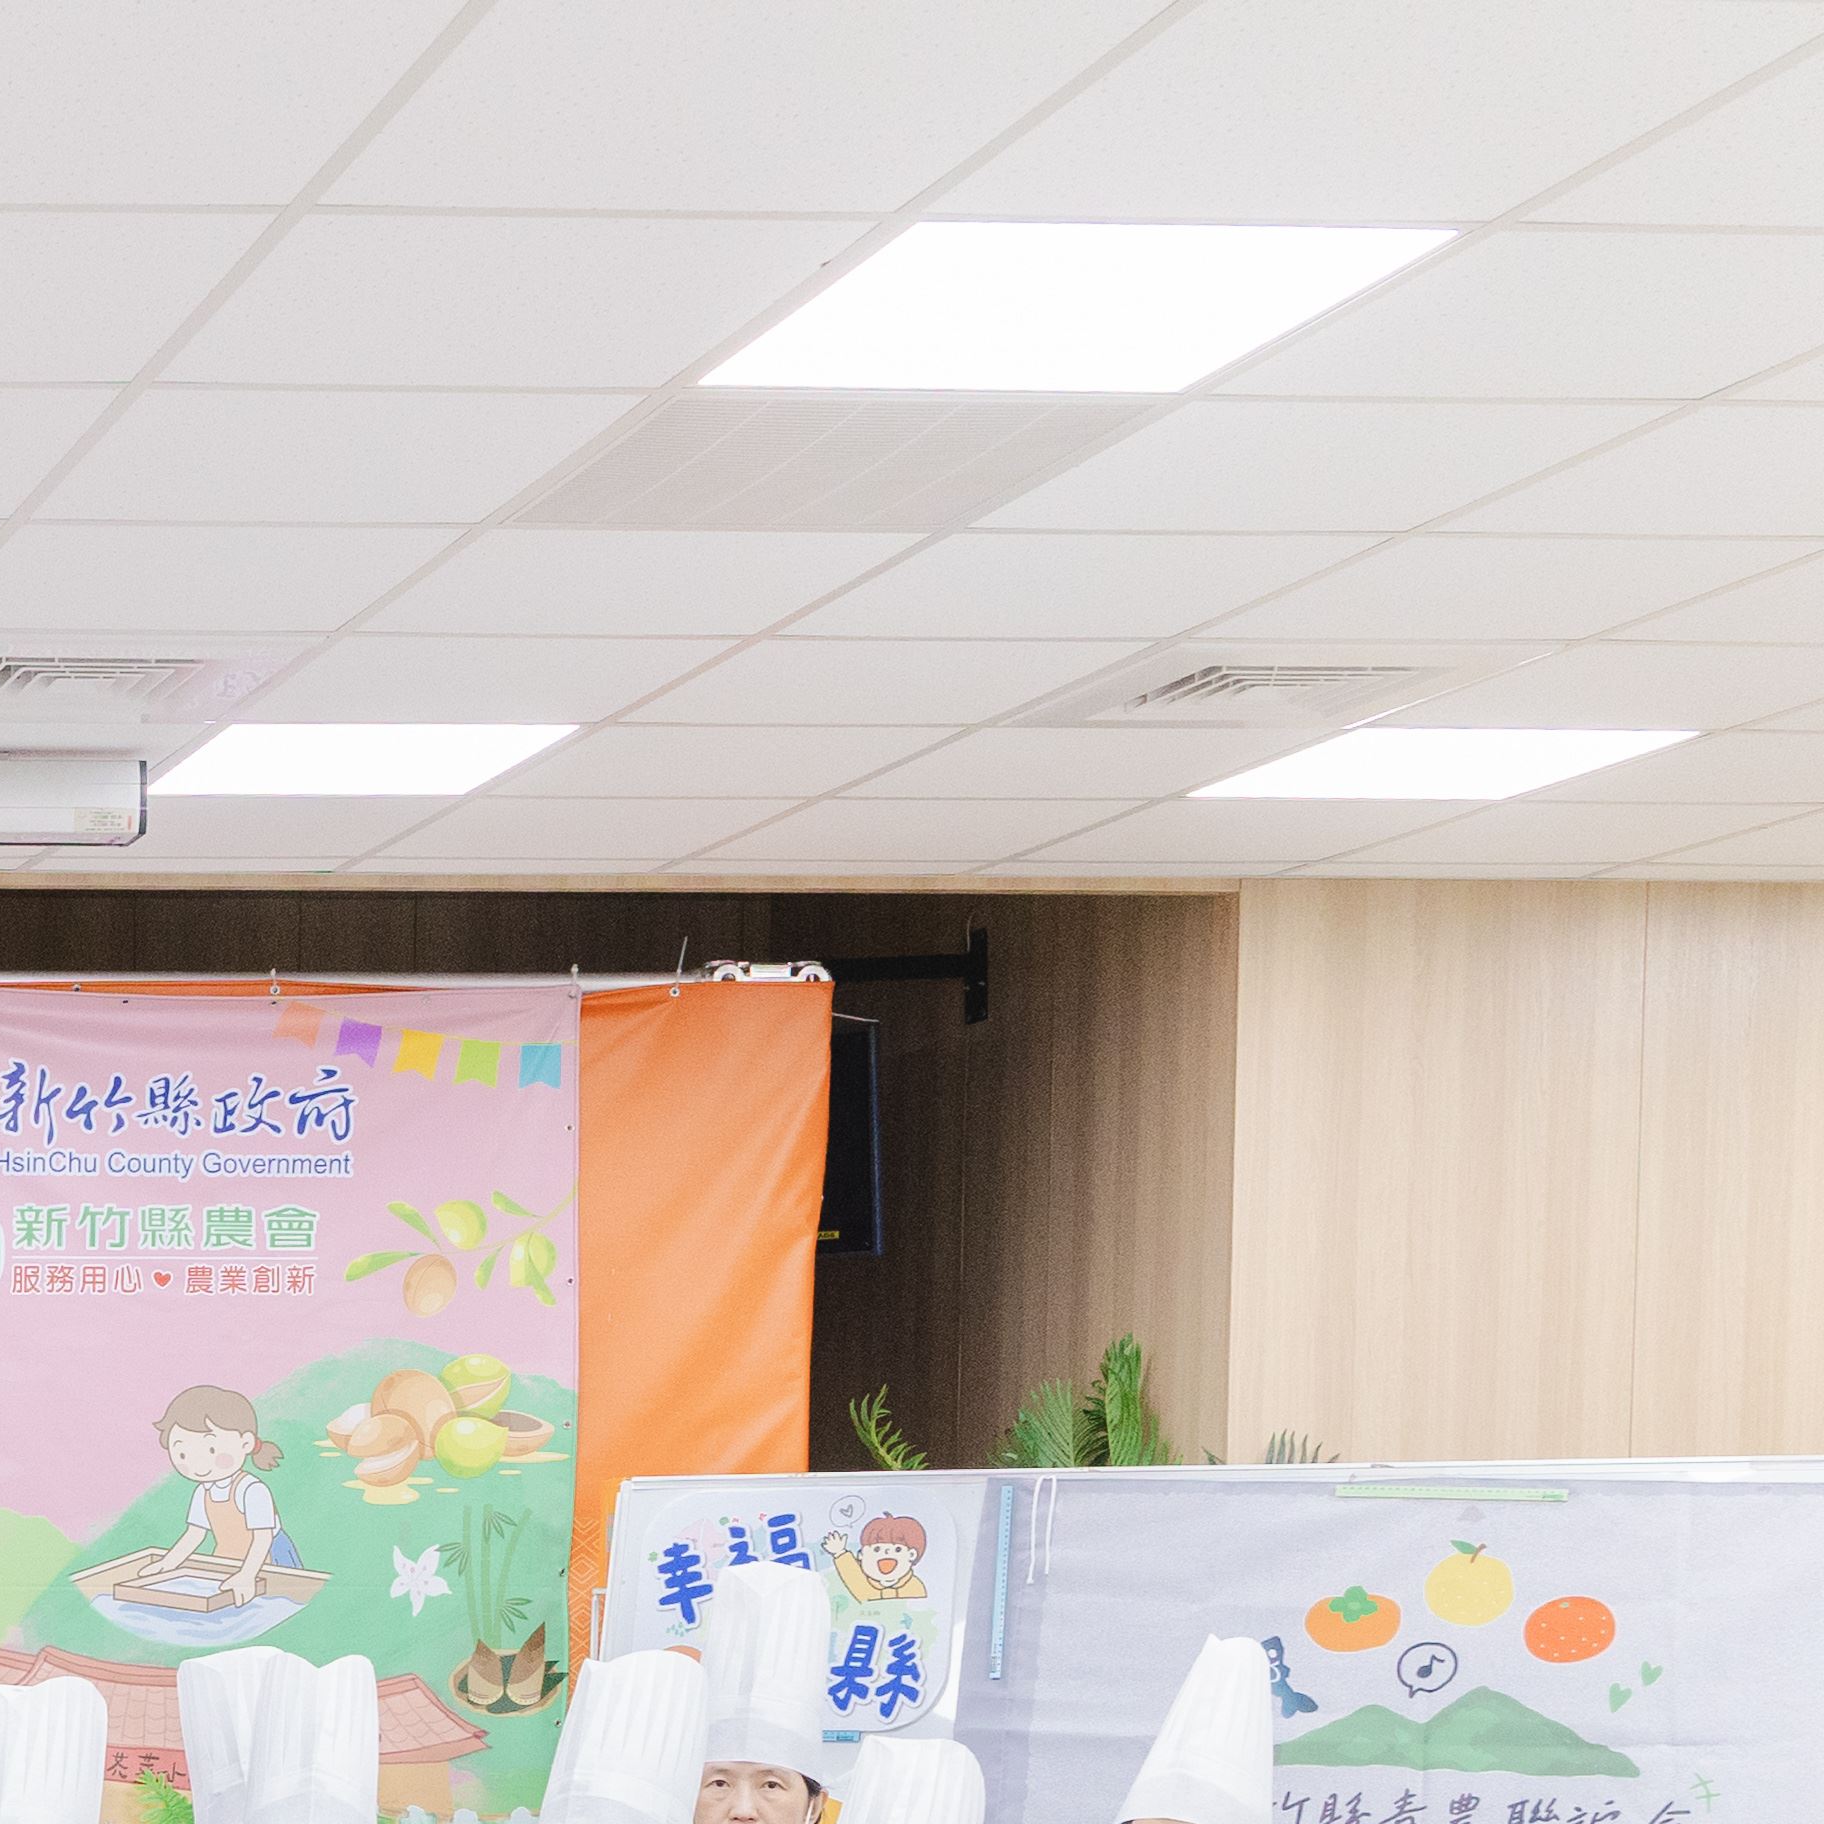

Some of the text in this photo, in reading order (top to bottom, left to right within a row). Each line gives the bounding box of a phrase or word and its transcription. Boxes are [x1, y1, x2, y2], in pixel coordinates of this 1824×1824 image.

[108, 1151, 193, 1179] County
[202, 1151, 352, 1176] Government
[13, 1206, 319, 1249] 新竹縣農會
[11, 1265, 316, 1295] 服務用心 農業創新
